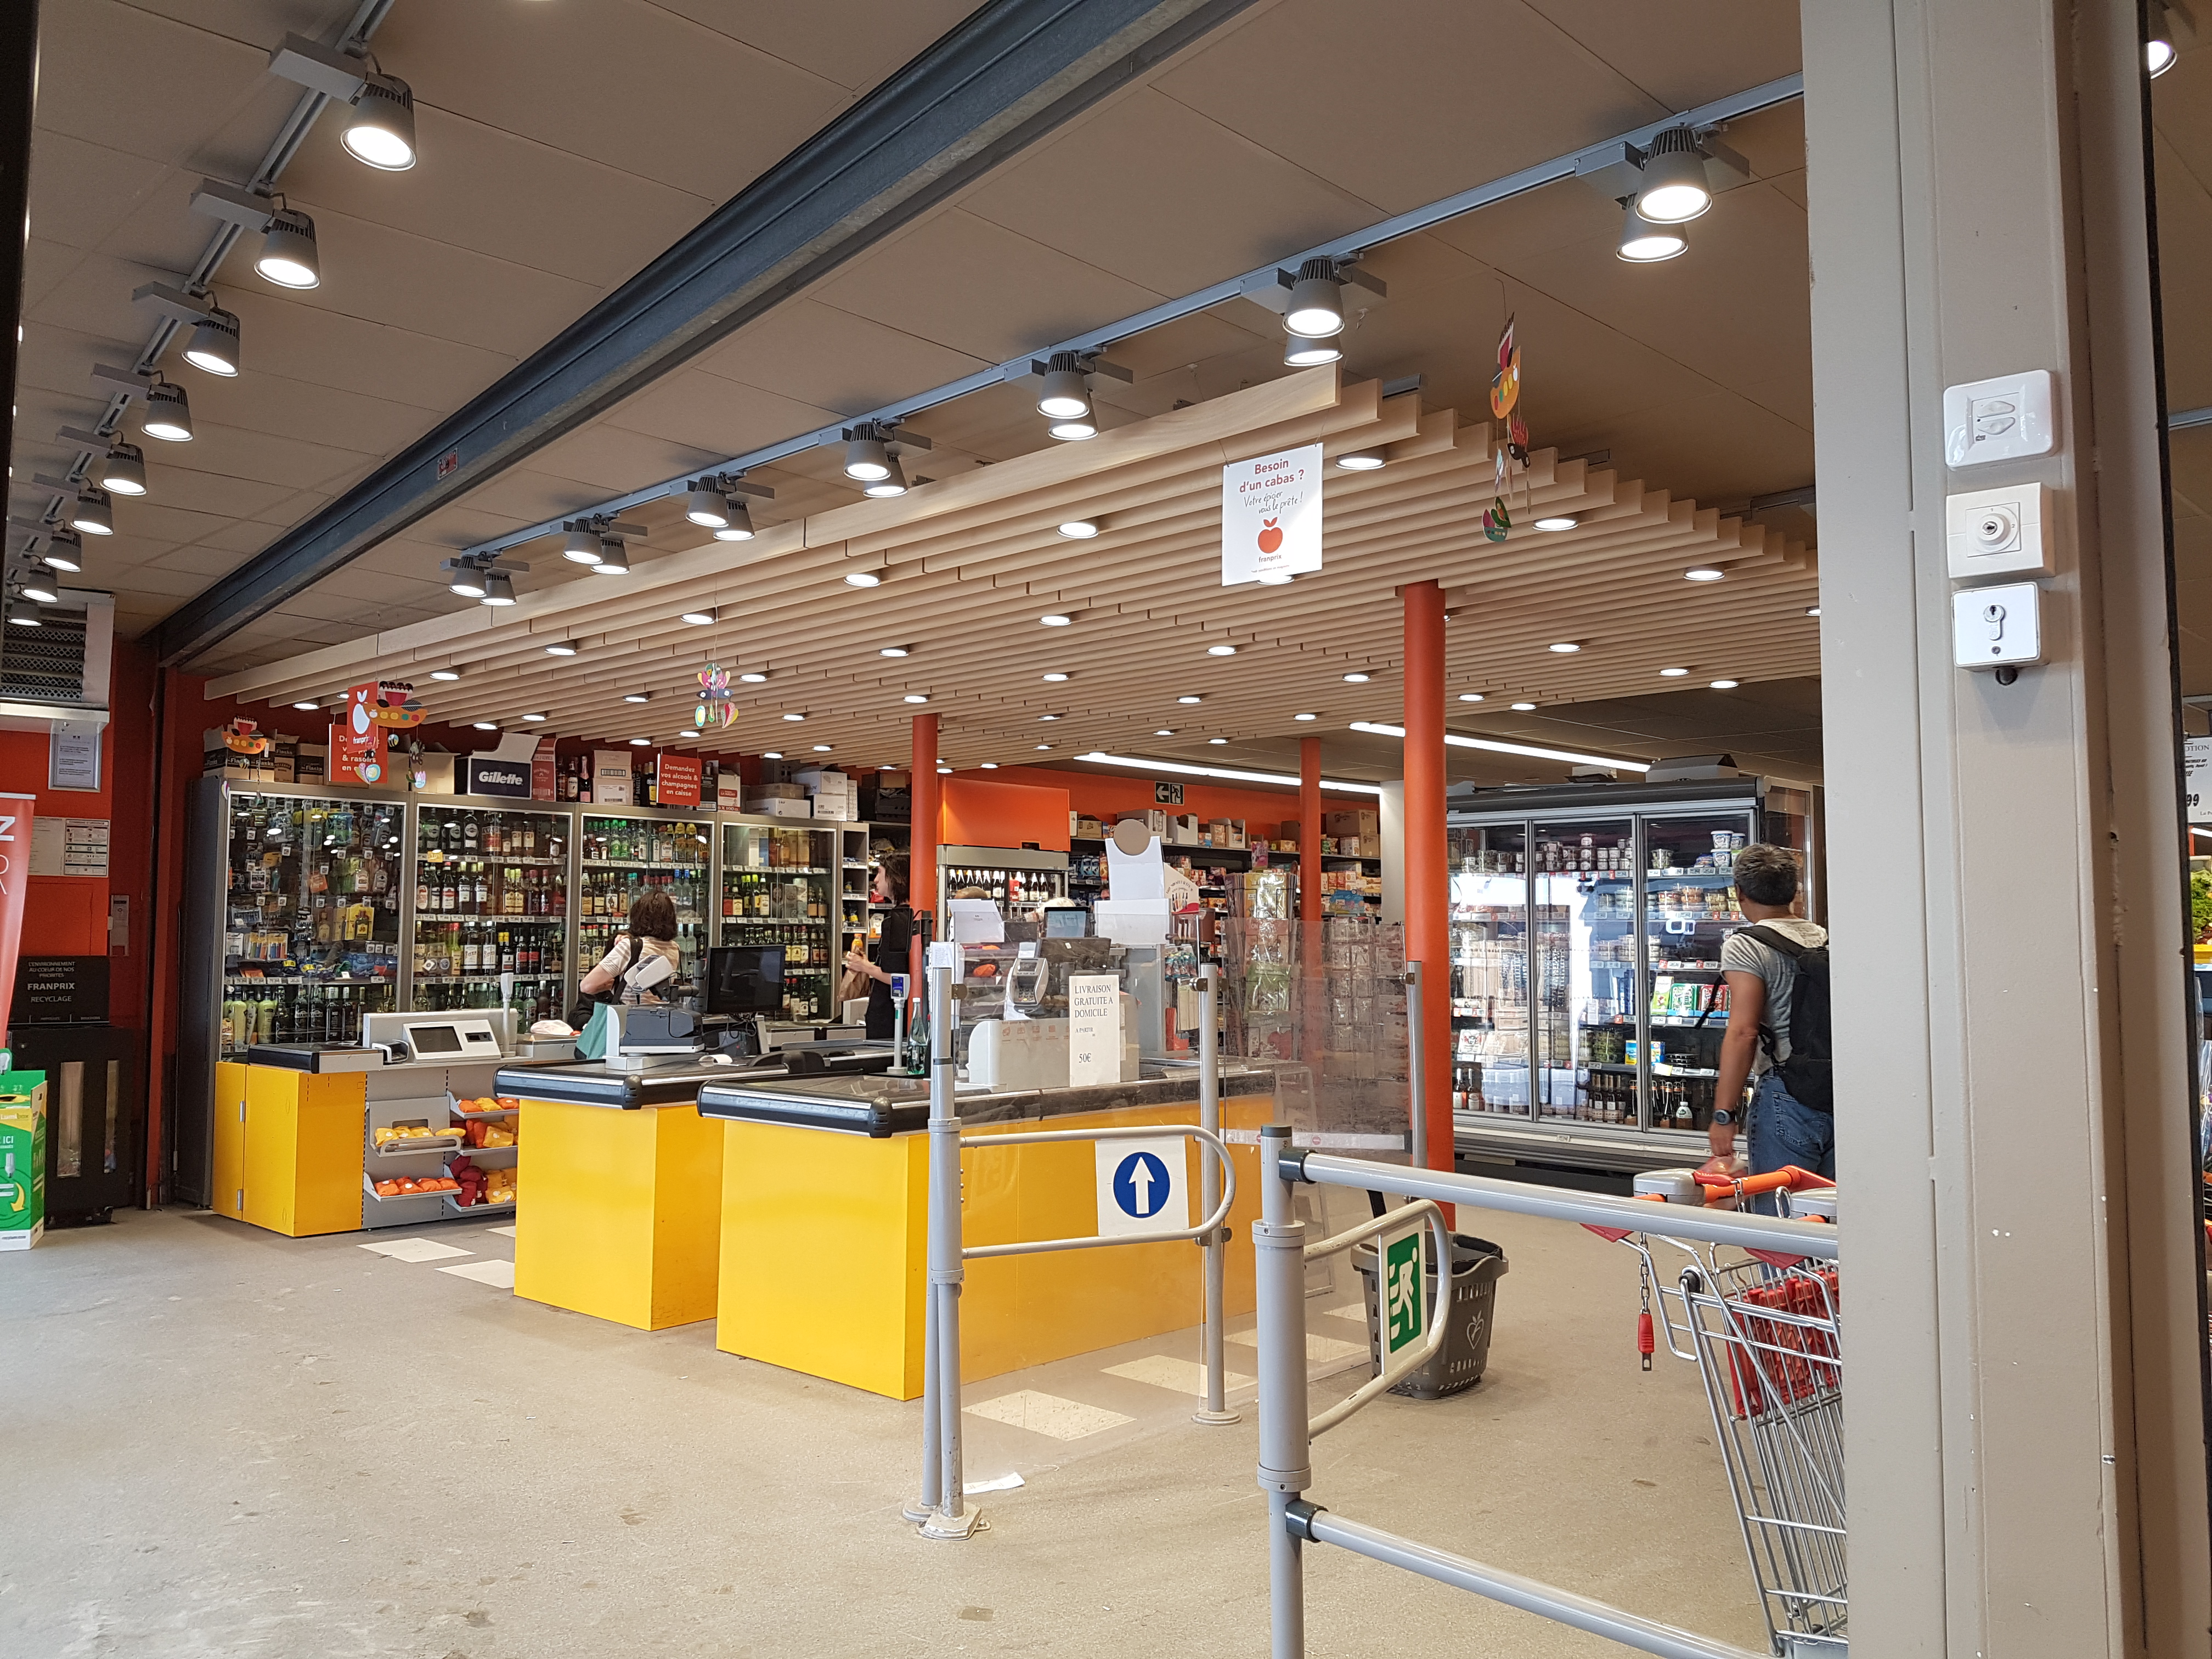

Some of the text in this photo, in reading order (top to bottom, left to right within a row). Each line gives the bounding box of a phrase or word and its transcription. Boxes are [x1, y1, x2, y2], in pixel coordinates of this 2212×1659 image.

[1255, 459, 1289, 475] Besoin
[1240, 469, 1305, 493] d'un cabas ?
[1244, 492, 1283, 507] Votre épicier
[1259, 491, 1304, 514] vous le prête !
[1259, 554, 1282, 563] franprix
[664, 764, 695, 773] Demandez
[478, 771, 523, 786] Gillette
[672, 772, 692, 781] alcools
[661, 780, 697, 789] champagnes
[27, 983, 75, 991] FRANPRIX
[1075, 984, 1111, 994] LIVRAISON
[1074, 997, 1107, 1006] GRATUITE
[1075, 1008, 1108, 1018] DOMICILE
[1079, 1053, 1091, 1063] 50€
[3, 1135, 14, 1144] ICI
